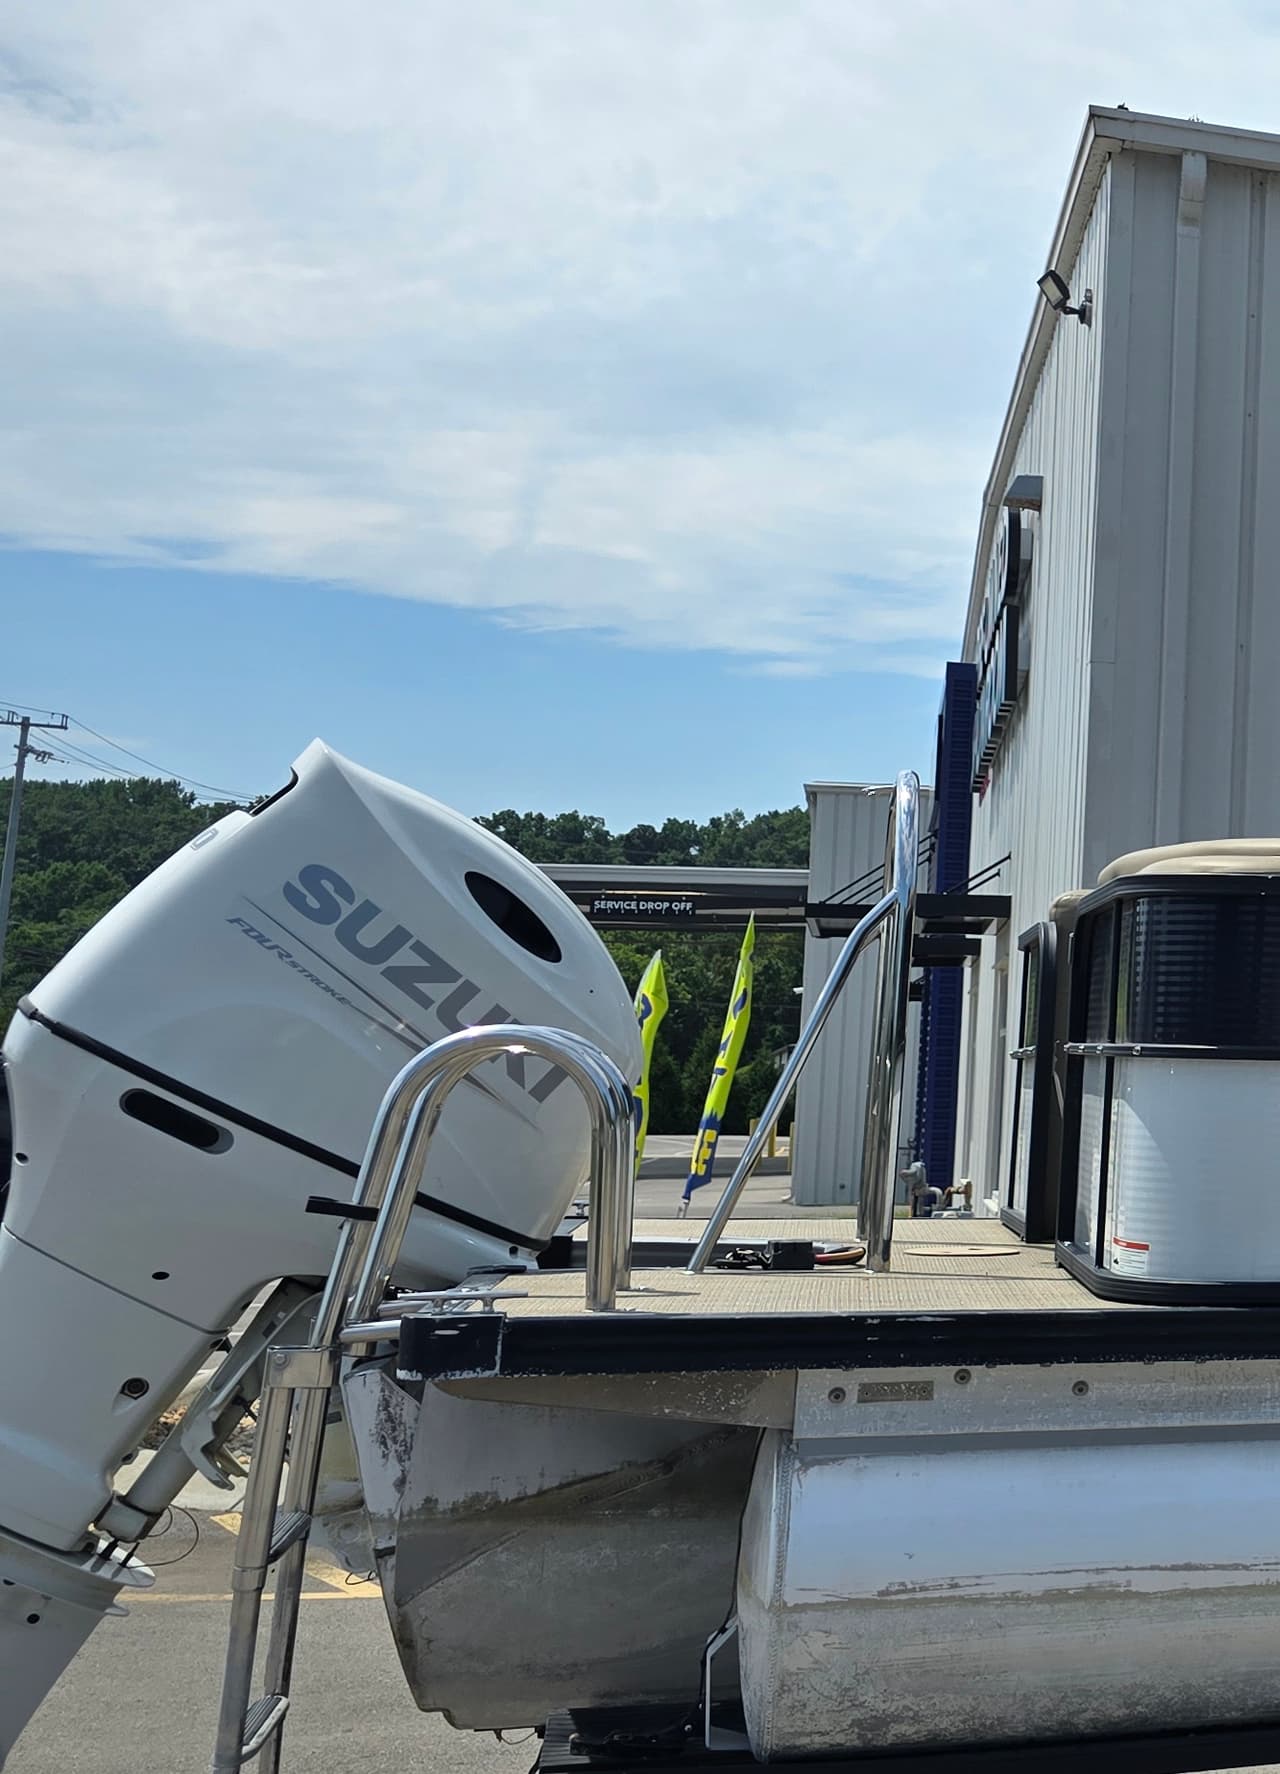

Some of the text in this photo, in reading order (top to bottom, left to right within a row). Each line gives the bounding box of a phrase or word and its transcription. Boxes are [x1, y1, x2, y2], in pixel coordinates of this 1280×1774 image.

[594, 900, 693, 911] SERVICE DROP OFF
